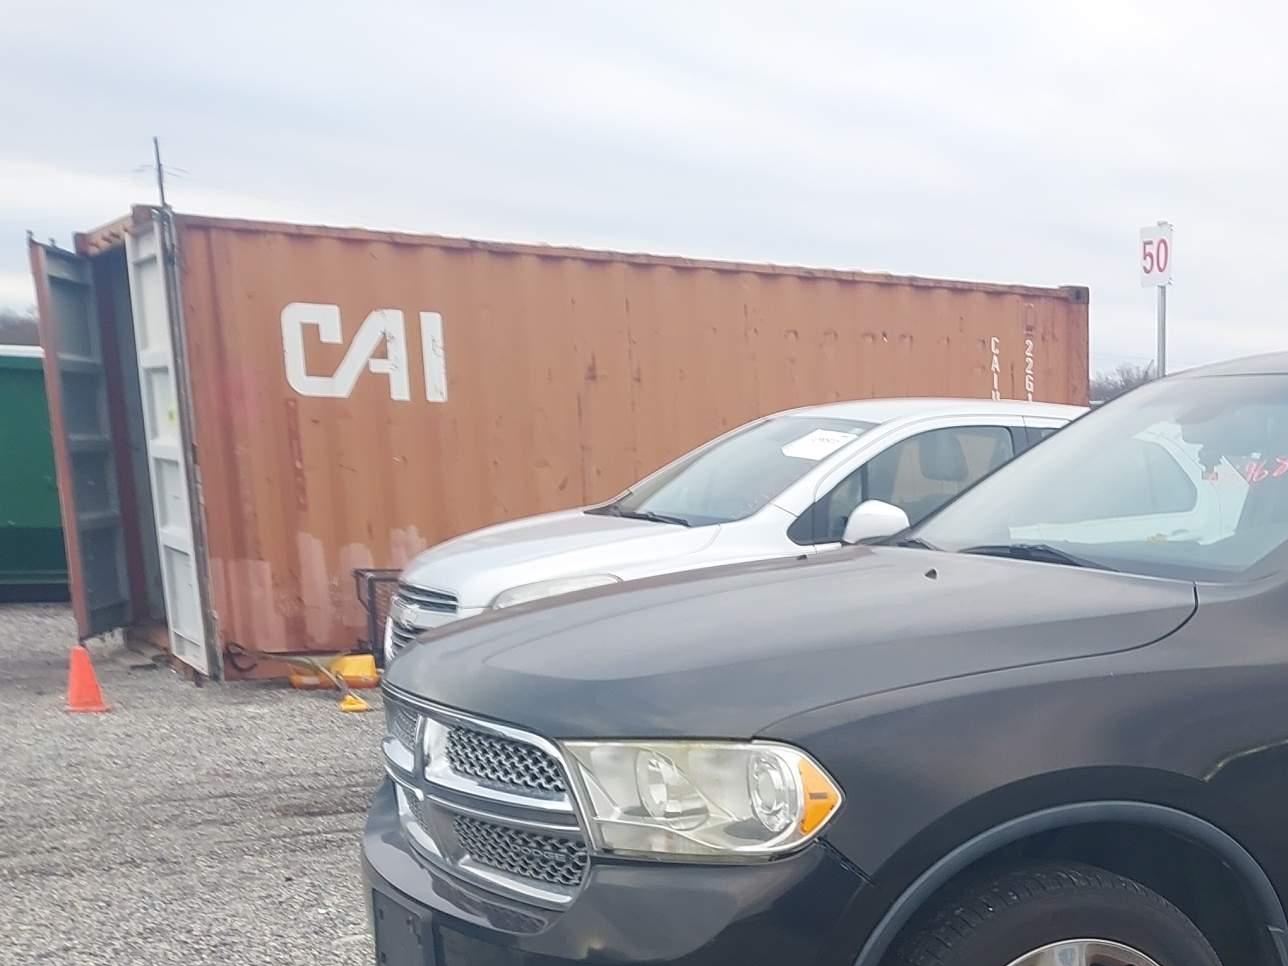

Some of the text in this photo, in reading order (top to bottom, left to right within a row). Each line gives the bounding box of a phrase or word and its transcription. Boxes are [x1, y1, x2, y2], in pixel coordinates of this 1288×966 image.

[1142, 238, 1169, 275] 50
[280, 302, 448, 403] CAI
[510, 843, 567, 863] DODGE
